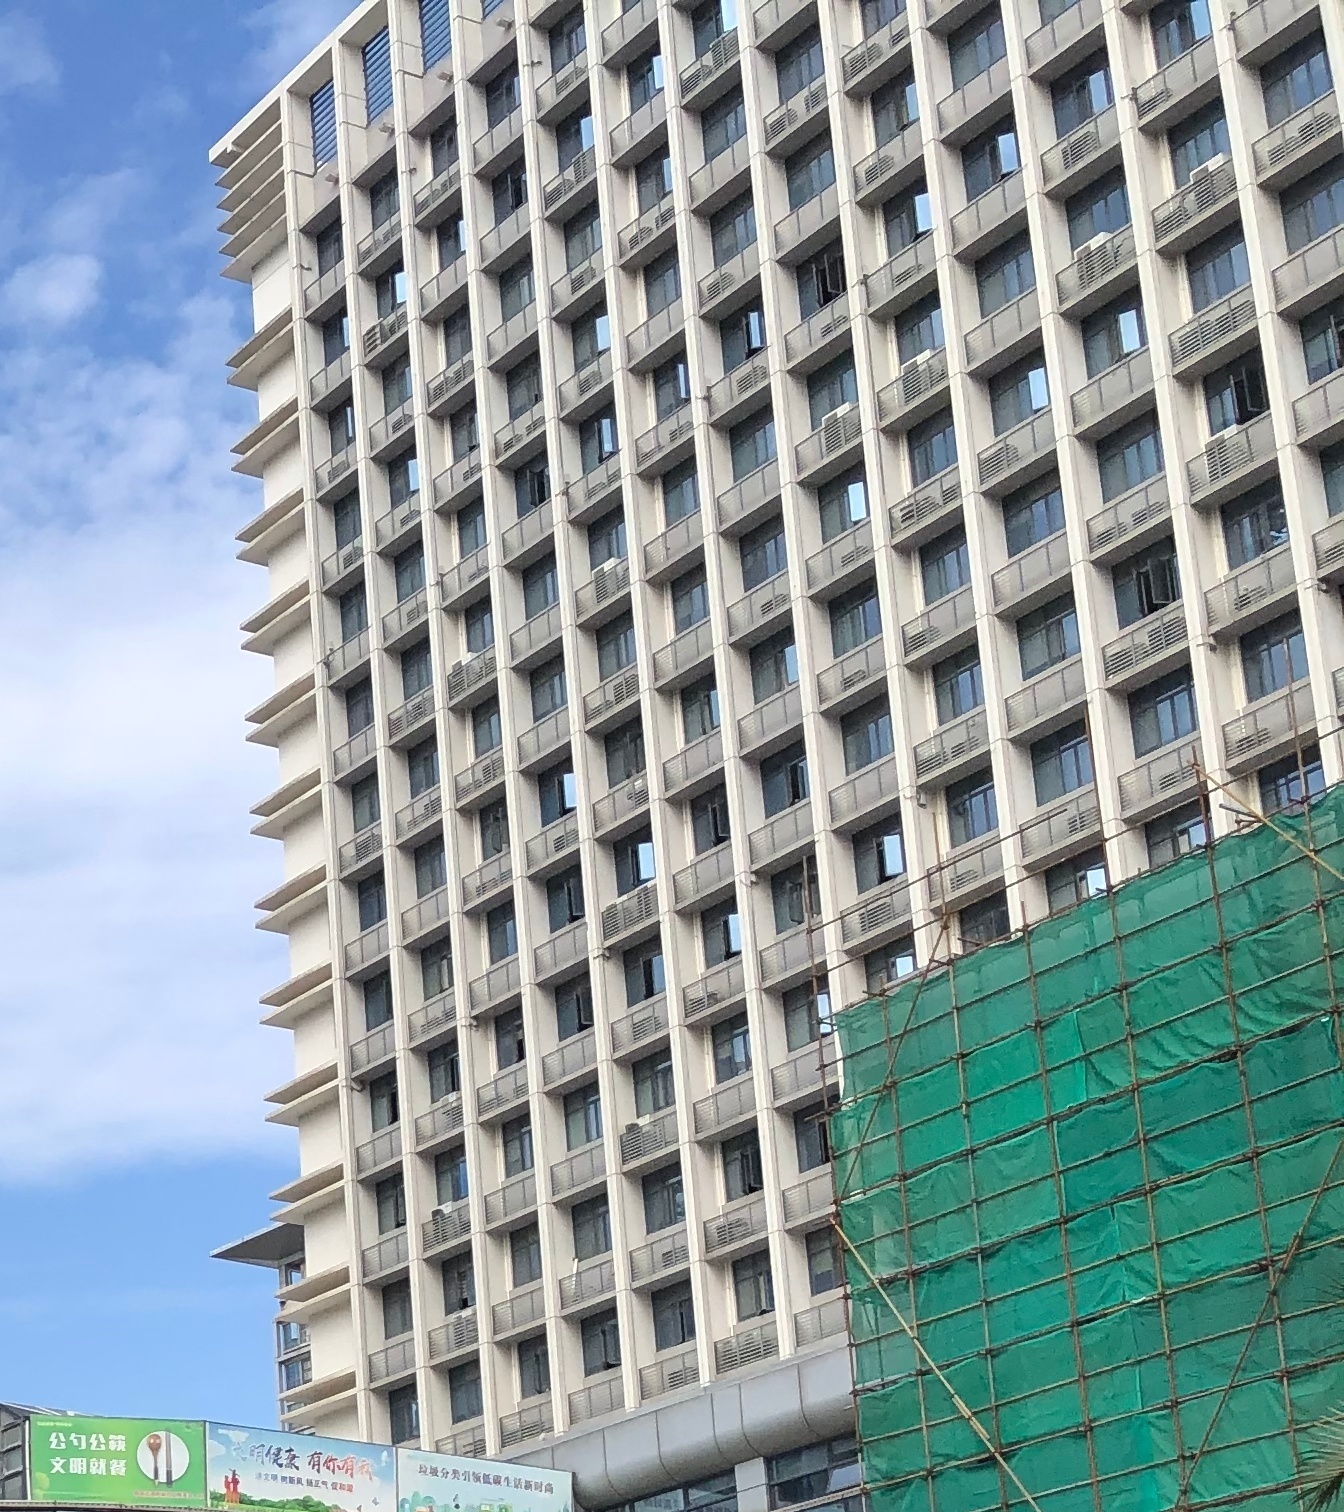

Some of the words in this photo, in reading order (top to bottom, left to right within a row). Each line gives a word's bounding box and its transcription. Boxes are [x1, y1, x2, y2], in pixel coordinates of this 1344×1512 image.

[49, 1432, 126, 1452] 公勺公筷
[49, 1456, 127, 1476] 文明就餐
